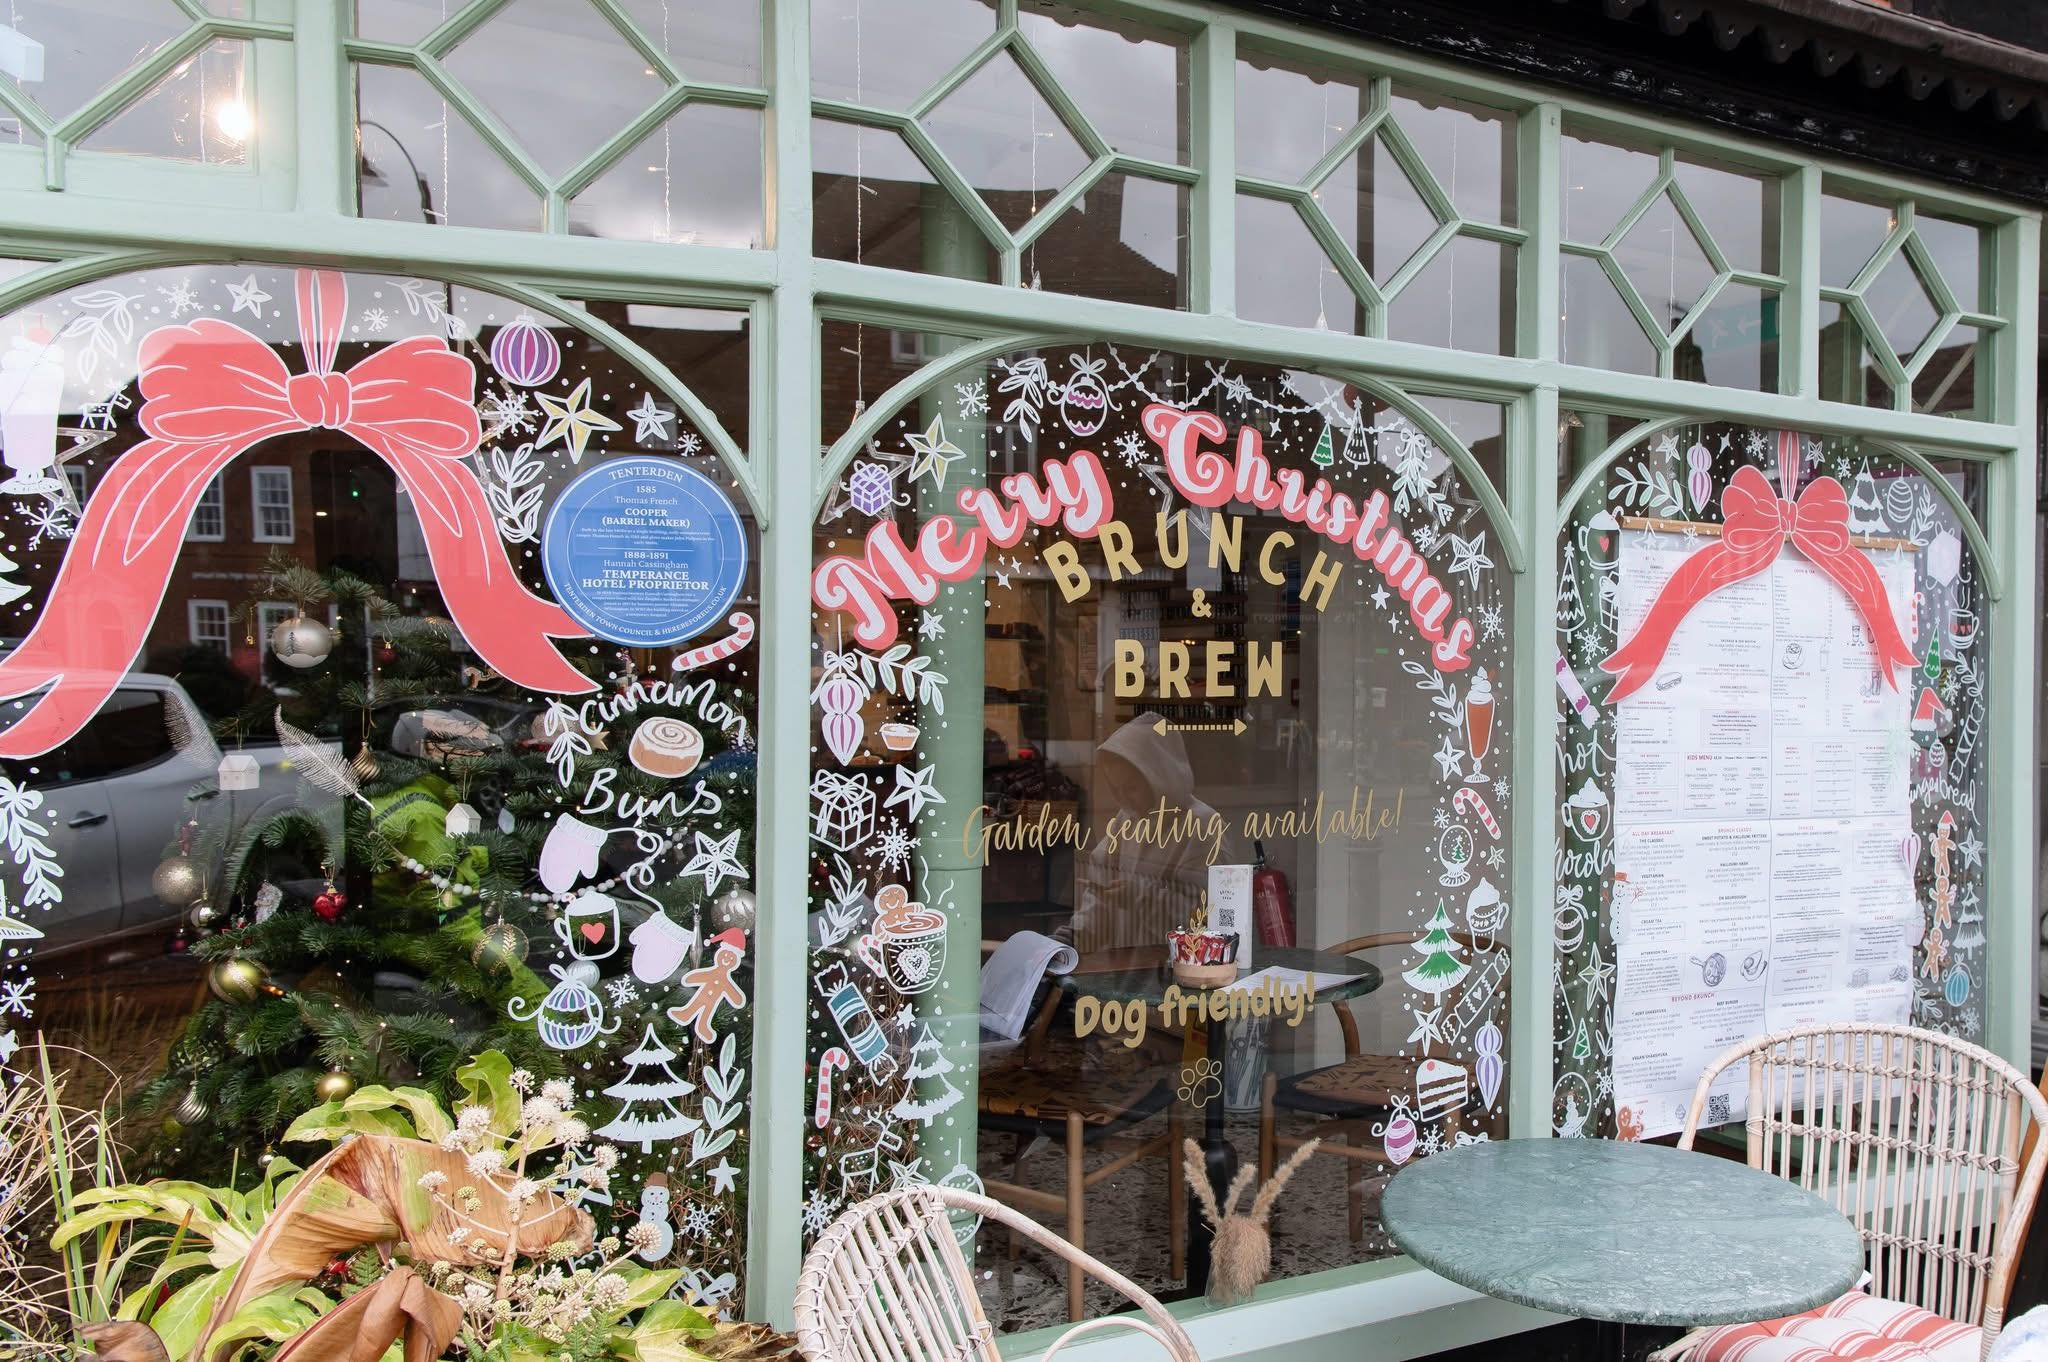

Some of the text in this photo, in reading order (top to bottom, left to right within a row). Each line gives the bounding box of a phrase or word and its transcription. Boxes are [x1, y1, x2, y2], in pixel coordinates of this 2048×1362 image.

[608, 467, 683, 483] TENTERDEN
[614, 496, 678, 505] Thomas French
[636, 485, 656, 493] 1585
[602, 516, 690, 528] (BARREL MAKER)
[624, 508, 668, 517] COOPER
[812, 450, 1113, 649] Merry
[1141, 404, 1475, 672] Christmas
[603, 560, 688, 570] Hannah Cassingham
[624, 551, 669, 560] 1888-1891
[1042, 512, 1343, 612] BRUNCH
[582, 579, 709, 590] HOTEL PROPRIETOR
[603, 569, 689, 581] TEMPERANCE
[564, 583, 595, 617] TENTERDEN
[595, 615, 619, 631] TOWN
[618, 625, 653, 637] COUNCIL
[1191, 588, 1212, 618] &
[1114, 639, 1283, 697] BREW
[580, 678, 748, 746] Cinnamon
[579, 768, 721, 818] Buns
[962, 786, 1405, 866] Garden seating available!
[1074, 972, 1316, 1049] Dog friendly!
